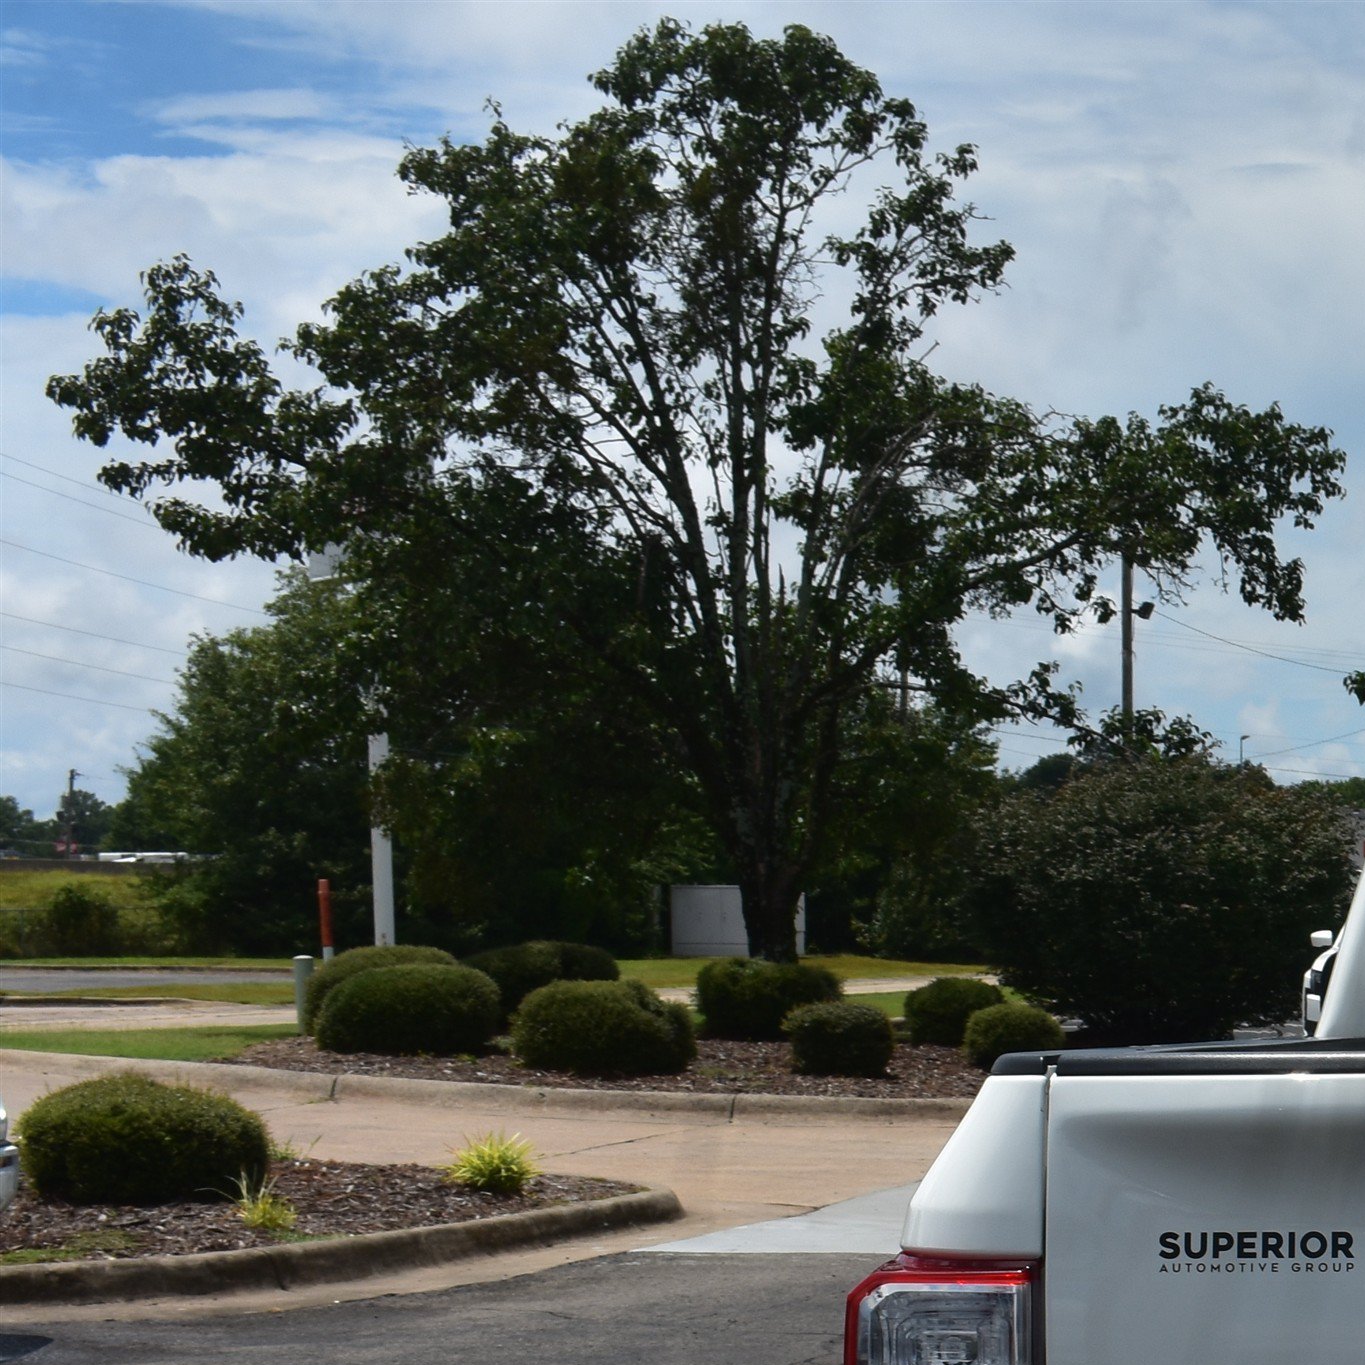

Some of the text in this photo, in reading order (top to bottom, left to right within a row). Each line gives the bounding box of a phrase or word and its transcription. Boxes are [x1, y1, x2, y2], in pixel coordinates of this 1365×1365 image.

[1158, 1231, 1355, 1260] SUPERIOR
[1158, 1262, 1355, 1273] AUTOMOTIVE GROUP
